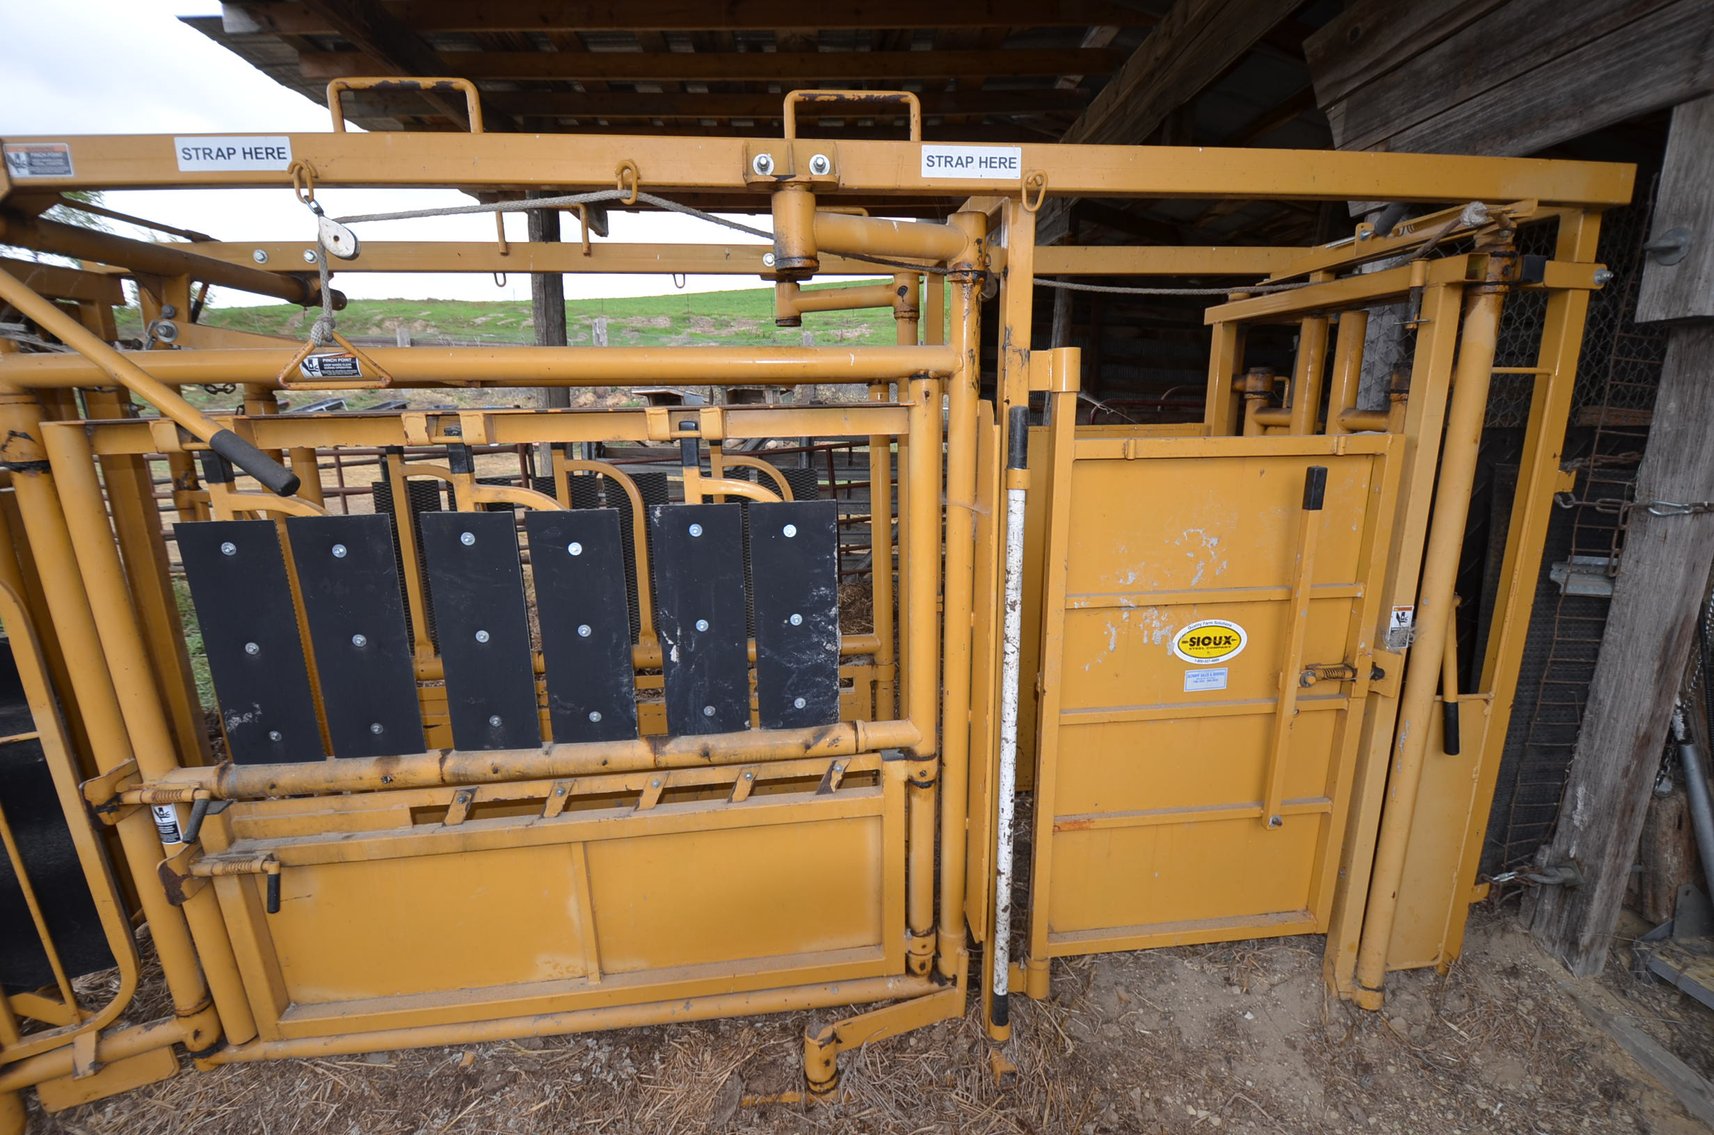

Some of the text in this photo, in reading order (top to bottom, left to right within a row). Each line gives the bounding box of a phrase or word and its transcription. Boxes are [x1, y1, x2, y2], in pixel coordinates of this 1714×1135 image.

[181, 146, 288, 160] STRAP HERE
[926, 154, 1017, 169] STRAP HERE
[1189, 636, 1232, 647] SIOUX
